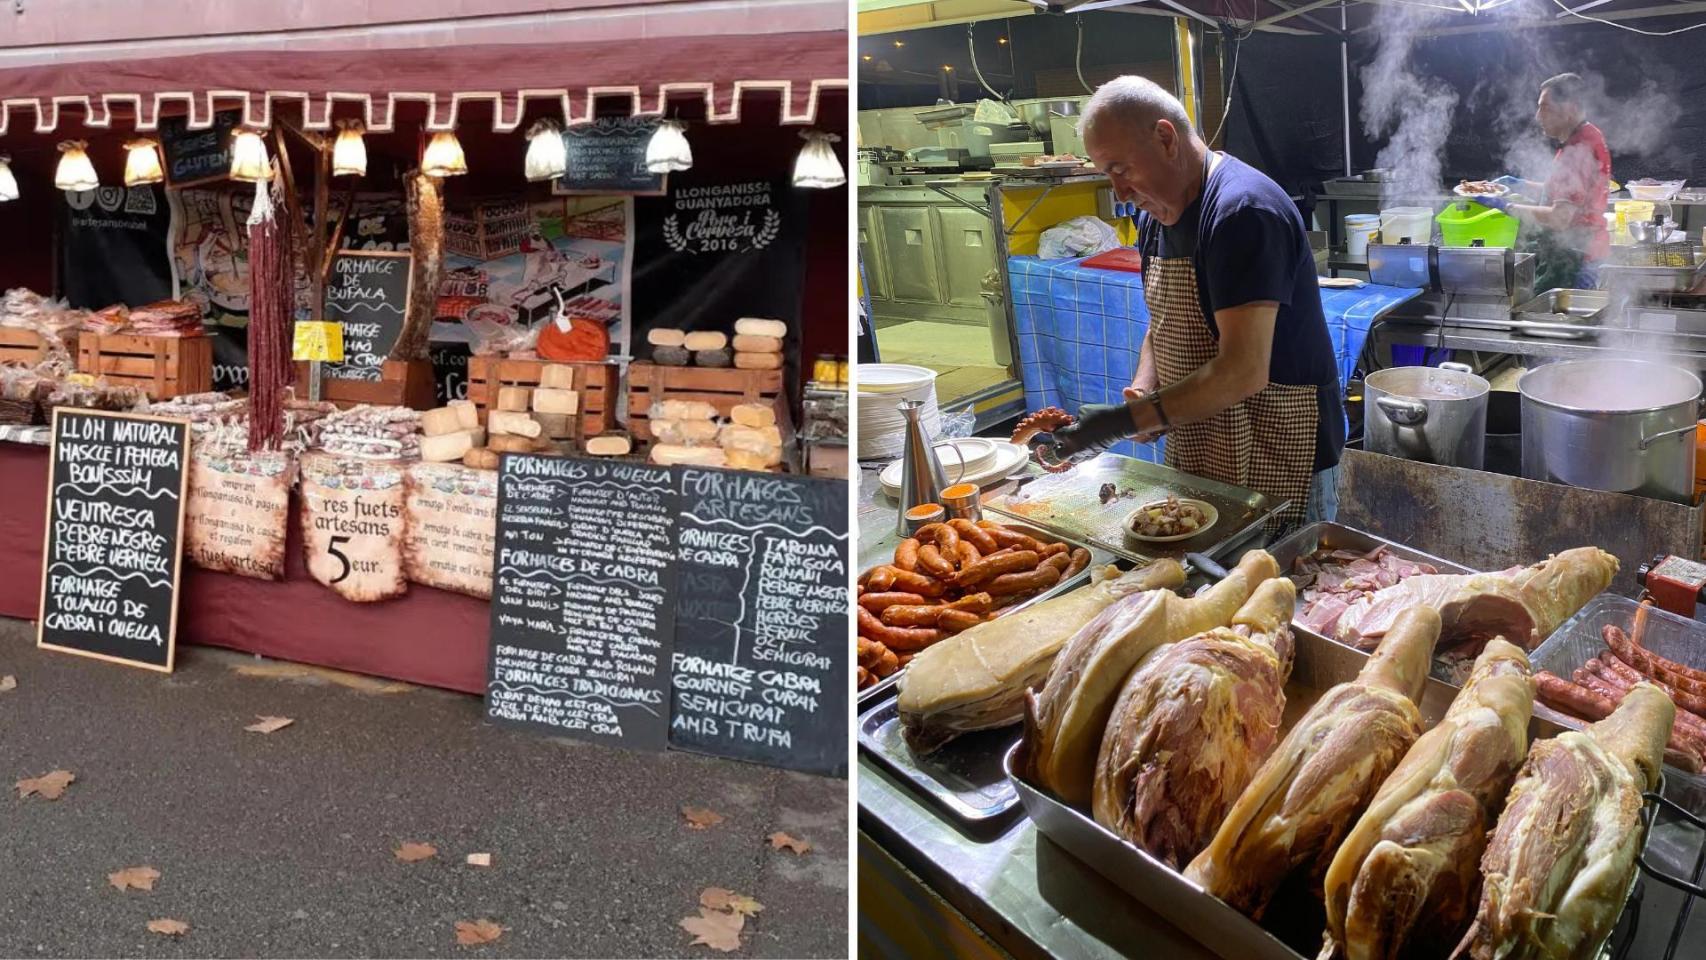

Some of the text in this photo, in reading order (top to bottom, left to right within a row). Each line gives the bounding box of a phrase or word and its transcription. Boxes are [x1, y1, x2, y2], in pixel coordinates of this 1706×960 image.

[675, 181, 771, 200] LLONGANISSA
[675, 193, 771, 210] GUANYADORA
[700, 239, 739, 252] 2016
[342, 274, 360, 288] DE
[327, 286, 387, 301] BUFALA
[113, 420, 179, 446] NATURAL
[123, 445, 179, 471] FEMELLA
[56, 497, 155, 529] VENTRESCA
[352, 494, 400, 519] fuets
[692, 499, 814, 525] ARTESANS
[315, 515, 390, 537] artesans
[55, 540, 169, 575] PEBRE VERMELL
[694, 549, 740, 569] CABRA
[764, 536, 839, 558] TARONJA
[327, 535, 384, 585] 5 eur.
[580, 559, 601, 576] DE
[604, 563, 659, 585] CABRA
[762, 551, 845, 577] FARIGOLA
[760, 563, 822, 584] ROMANI
[51, 574, 122, 598] FORMATGE
[758, 577, 808, 598] PEBRE
[123, 599, 149, 618] DE
[755, 593, 794, 612] PEBRE
[45, 612, 96, 632] CABRA
[108, 617, 164, 647] OVELLA
[756, 610, 820, 630] HERBES
[540, 651, 557, 663] DE
[752, 645, 832, 670] SEMICURAT
[671, 652, 822, 694] FORMATGE CABRA
[678, 692, 785, 724] SEMICURAT
[761, 688, 819, 713] CURAT
[671, 713, 792, 749] AMB TRUFA
